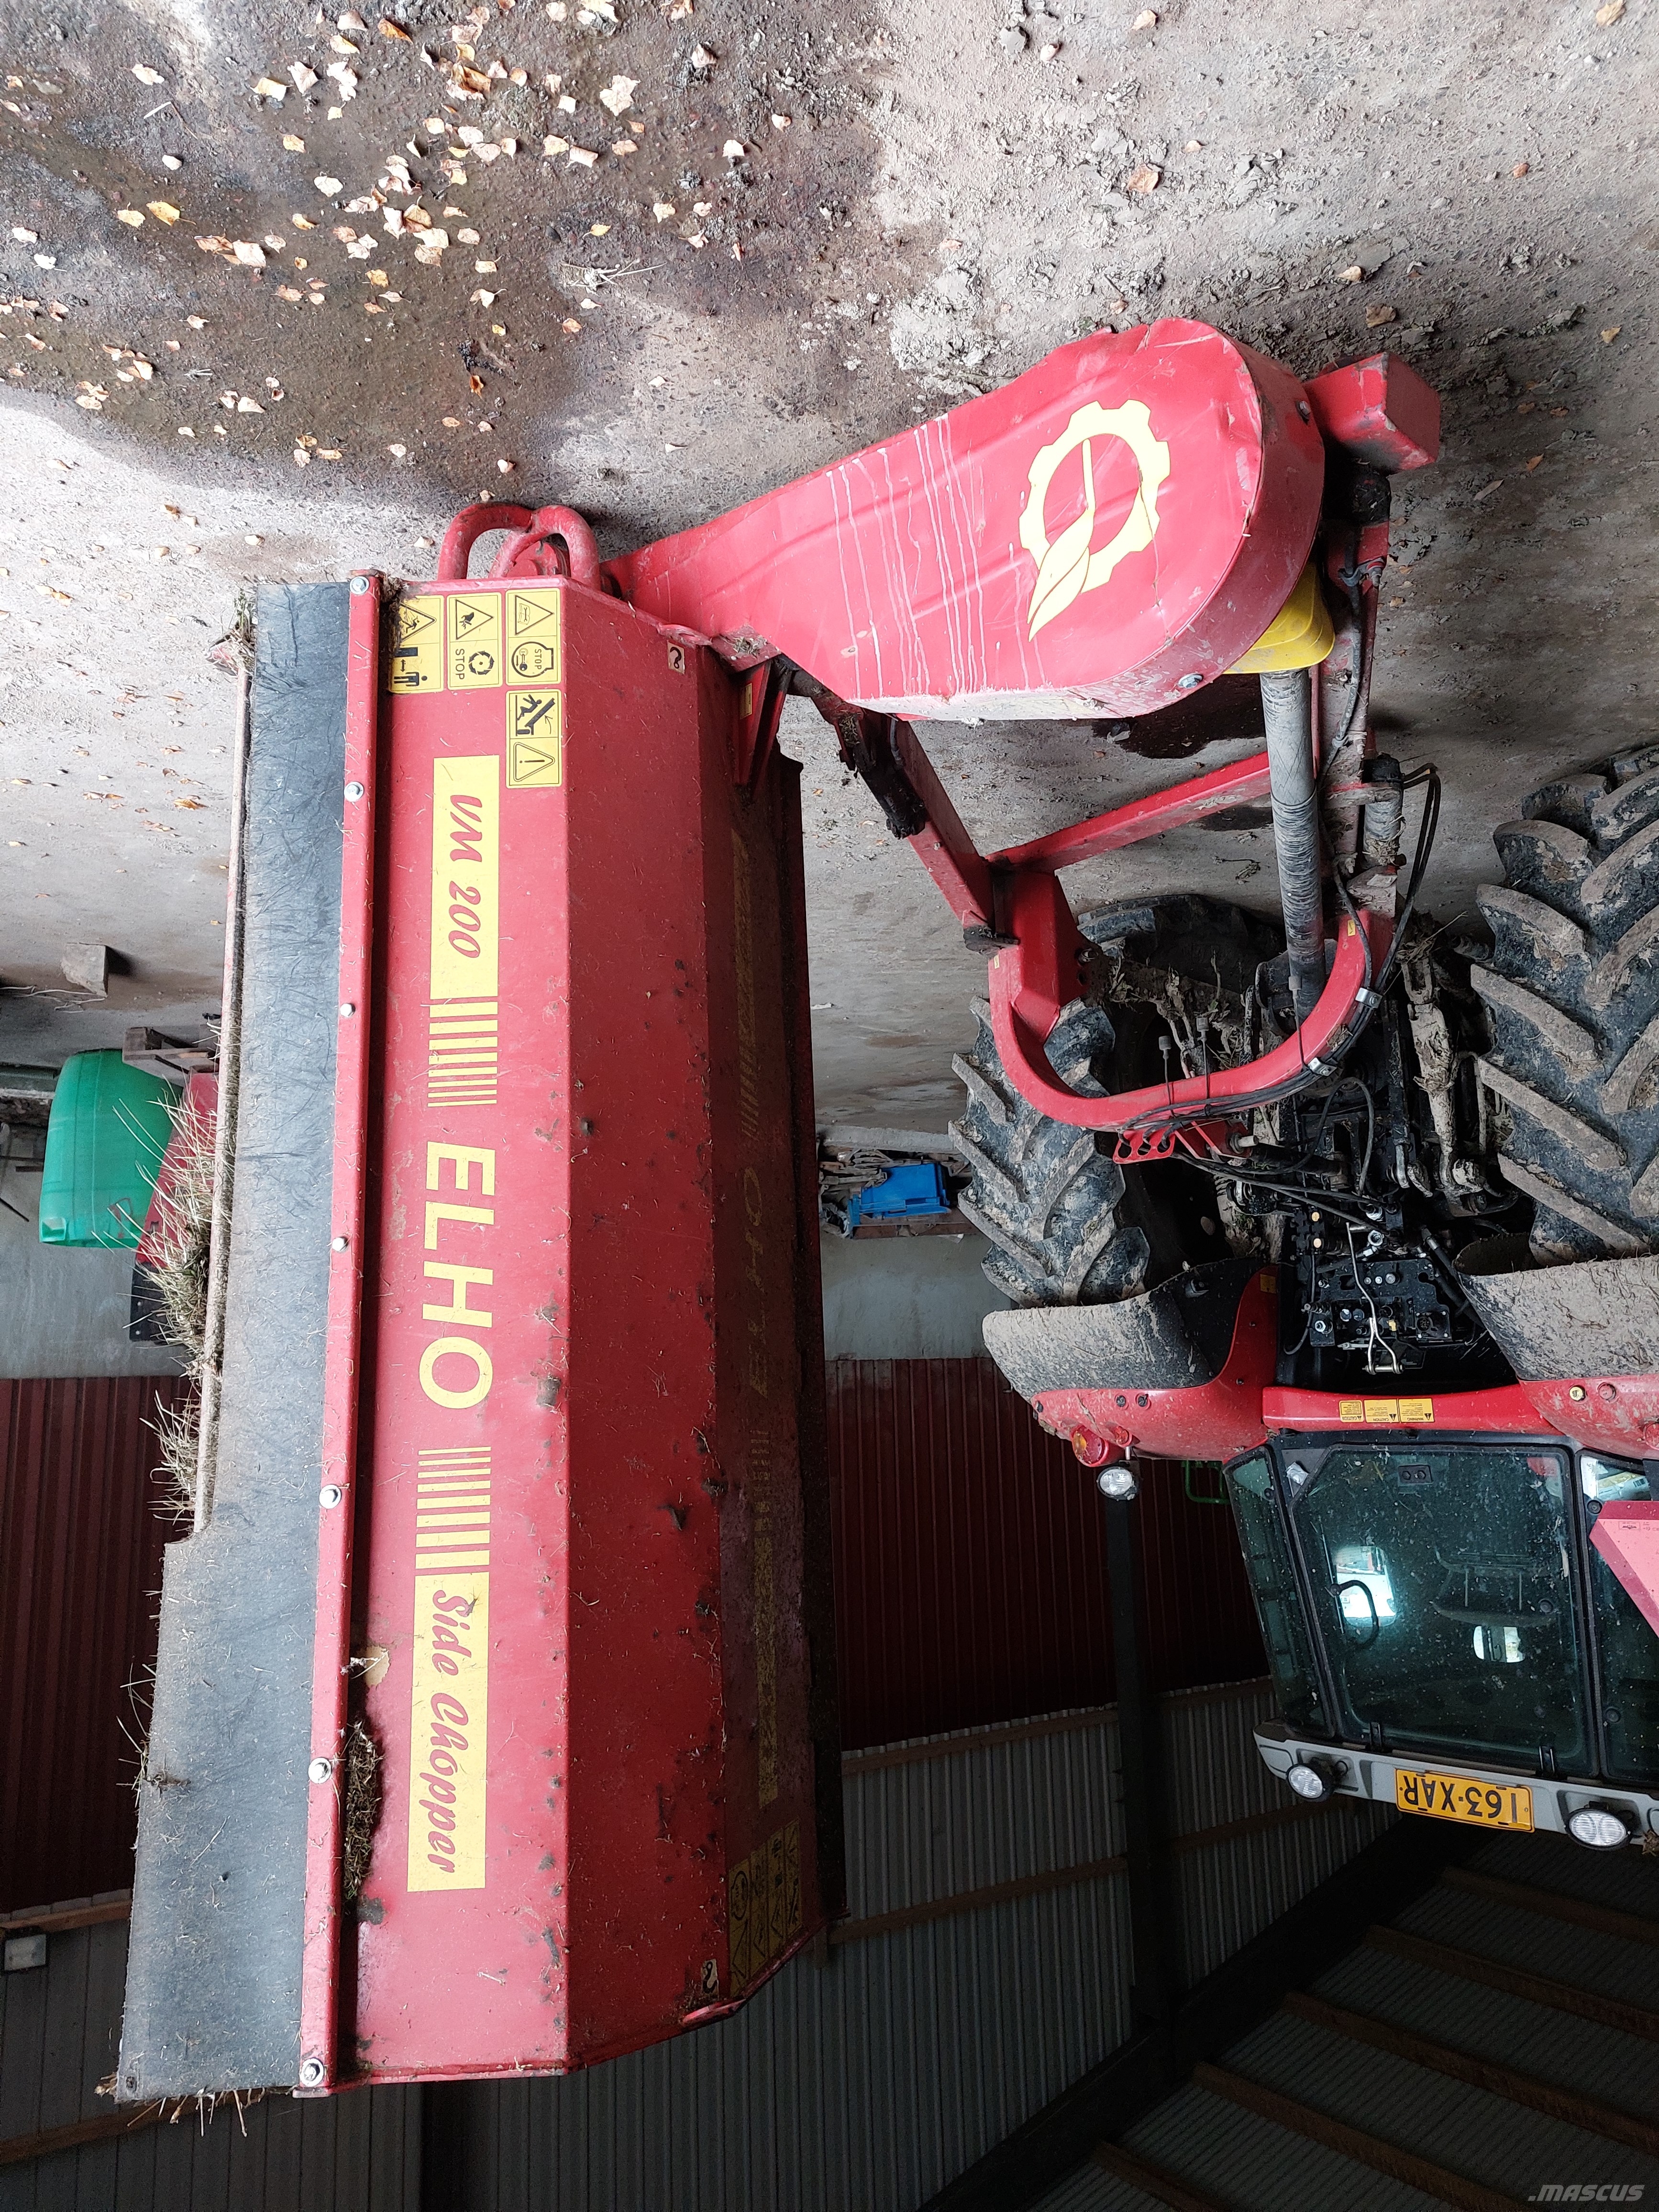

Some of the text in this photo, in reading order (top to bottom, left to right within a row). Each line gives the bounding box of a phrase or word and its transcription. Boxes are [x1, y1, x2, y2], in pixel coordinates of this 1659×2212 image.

[455, 648, 465, 680] STOP
[449, 795, 483, 958] VM 200
[419, 1141, 495, 1409] ELHO
[419, 1590, 472, 1873] Side Chopper
